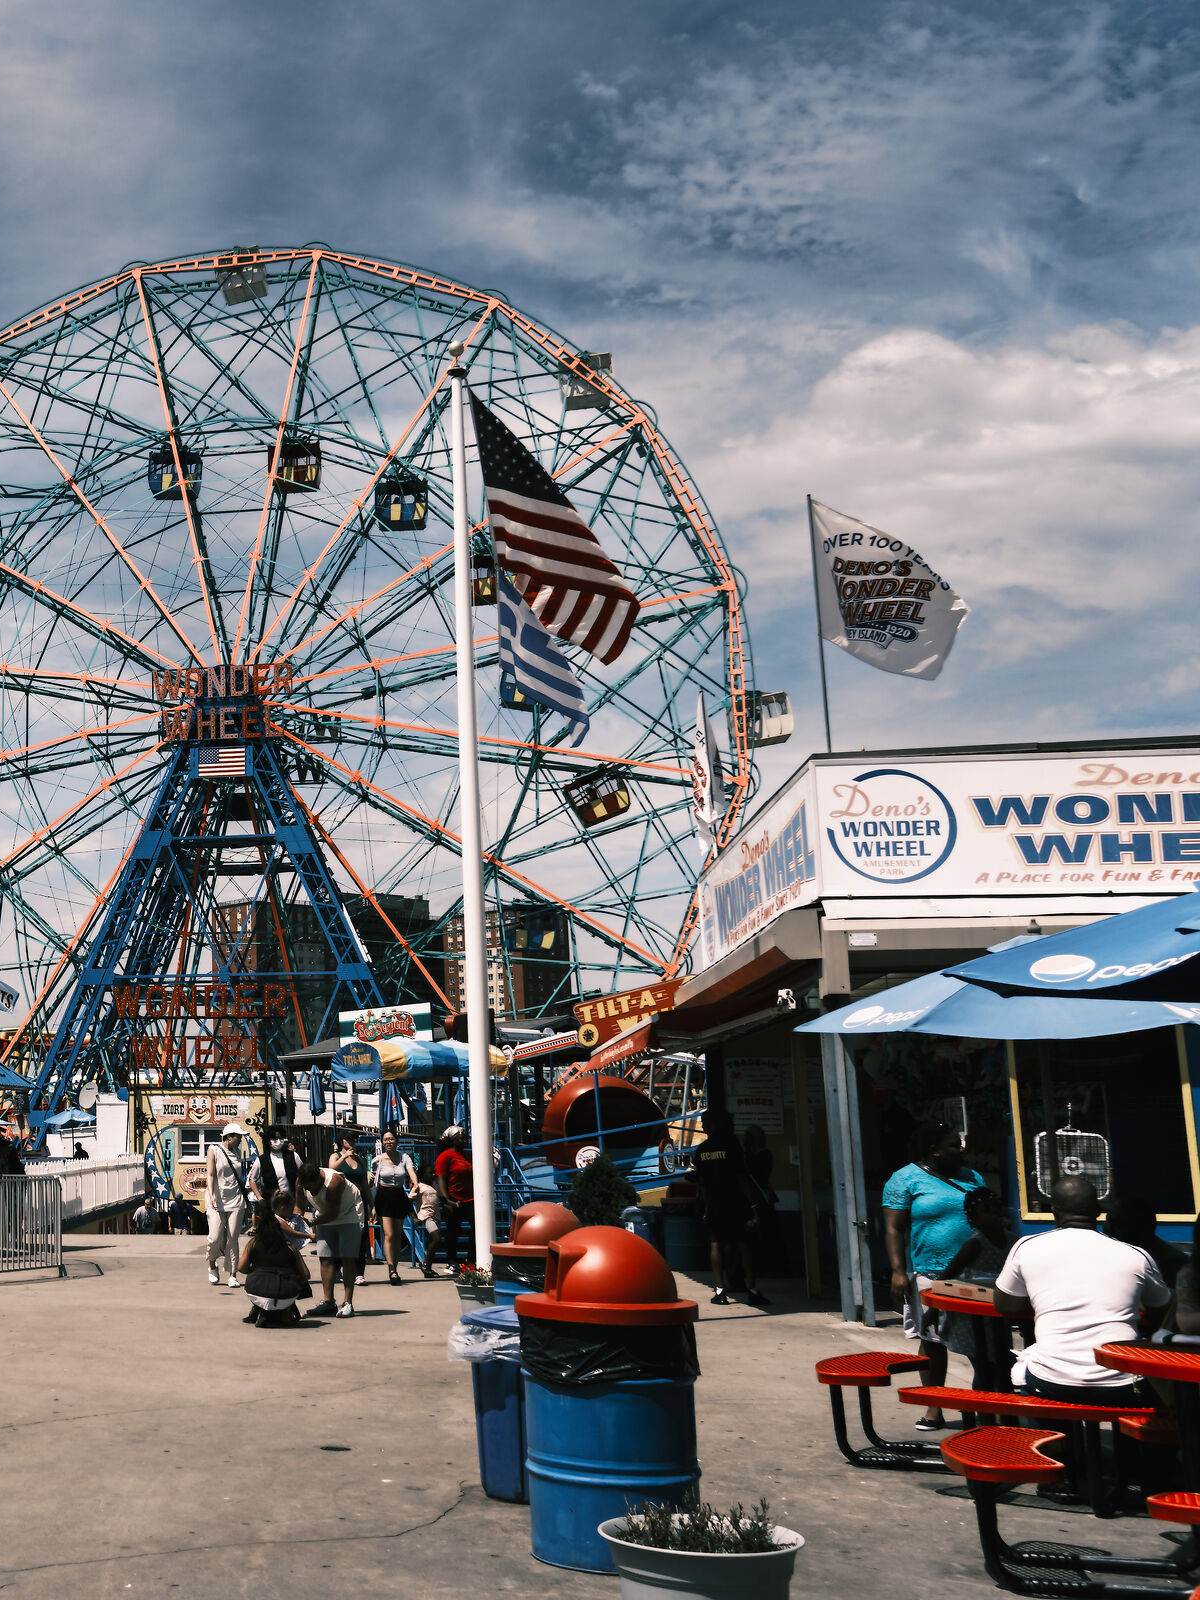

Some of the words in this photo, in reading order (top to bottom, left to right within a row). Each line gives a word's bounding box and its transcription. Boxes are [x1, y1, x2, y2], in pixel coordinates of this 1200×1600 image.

[823, 533, 863, 553] OVER
[869, 536, 903, 552] 100
[833, 557, 914, 577] DENO'S
[858, 629, 887, 644] ISLAND
[885, 624, 911, 639] 1920
[152, 662, 293, 700] WONDER
[162, 705, 285, 742] WHEEL
[829, 784, 931, 818] Deno's
[840, 820, 941, 837] WONDER
[741, 830, 770, 872] Deno's
[853, 841, 931, 857] WHEEL
[714, 863, 763, 945] WONDER
[762, 799, 816, 901] WHEEL
[863, 859, 921, 867] AMUSEMENT
[879, 868, 905, 876] PARK
[975, 872, 990, 884] A
[1148, 869, 1164, 881] &
[113, 984, 287, 1019] WONDER
[358, 1023, 374, 1038] Sea
[376, 1019, 410, 1036] Serpent
[132, 1035, 266, 1069] WHEEL
[163, 1103, 185, 1115] MORE
[215, 1104, 238, 1116] RIDES
[164, 1139, 172, 1172] FUN
